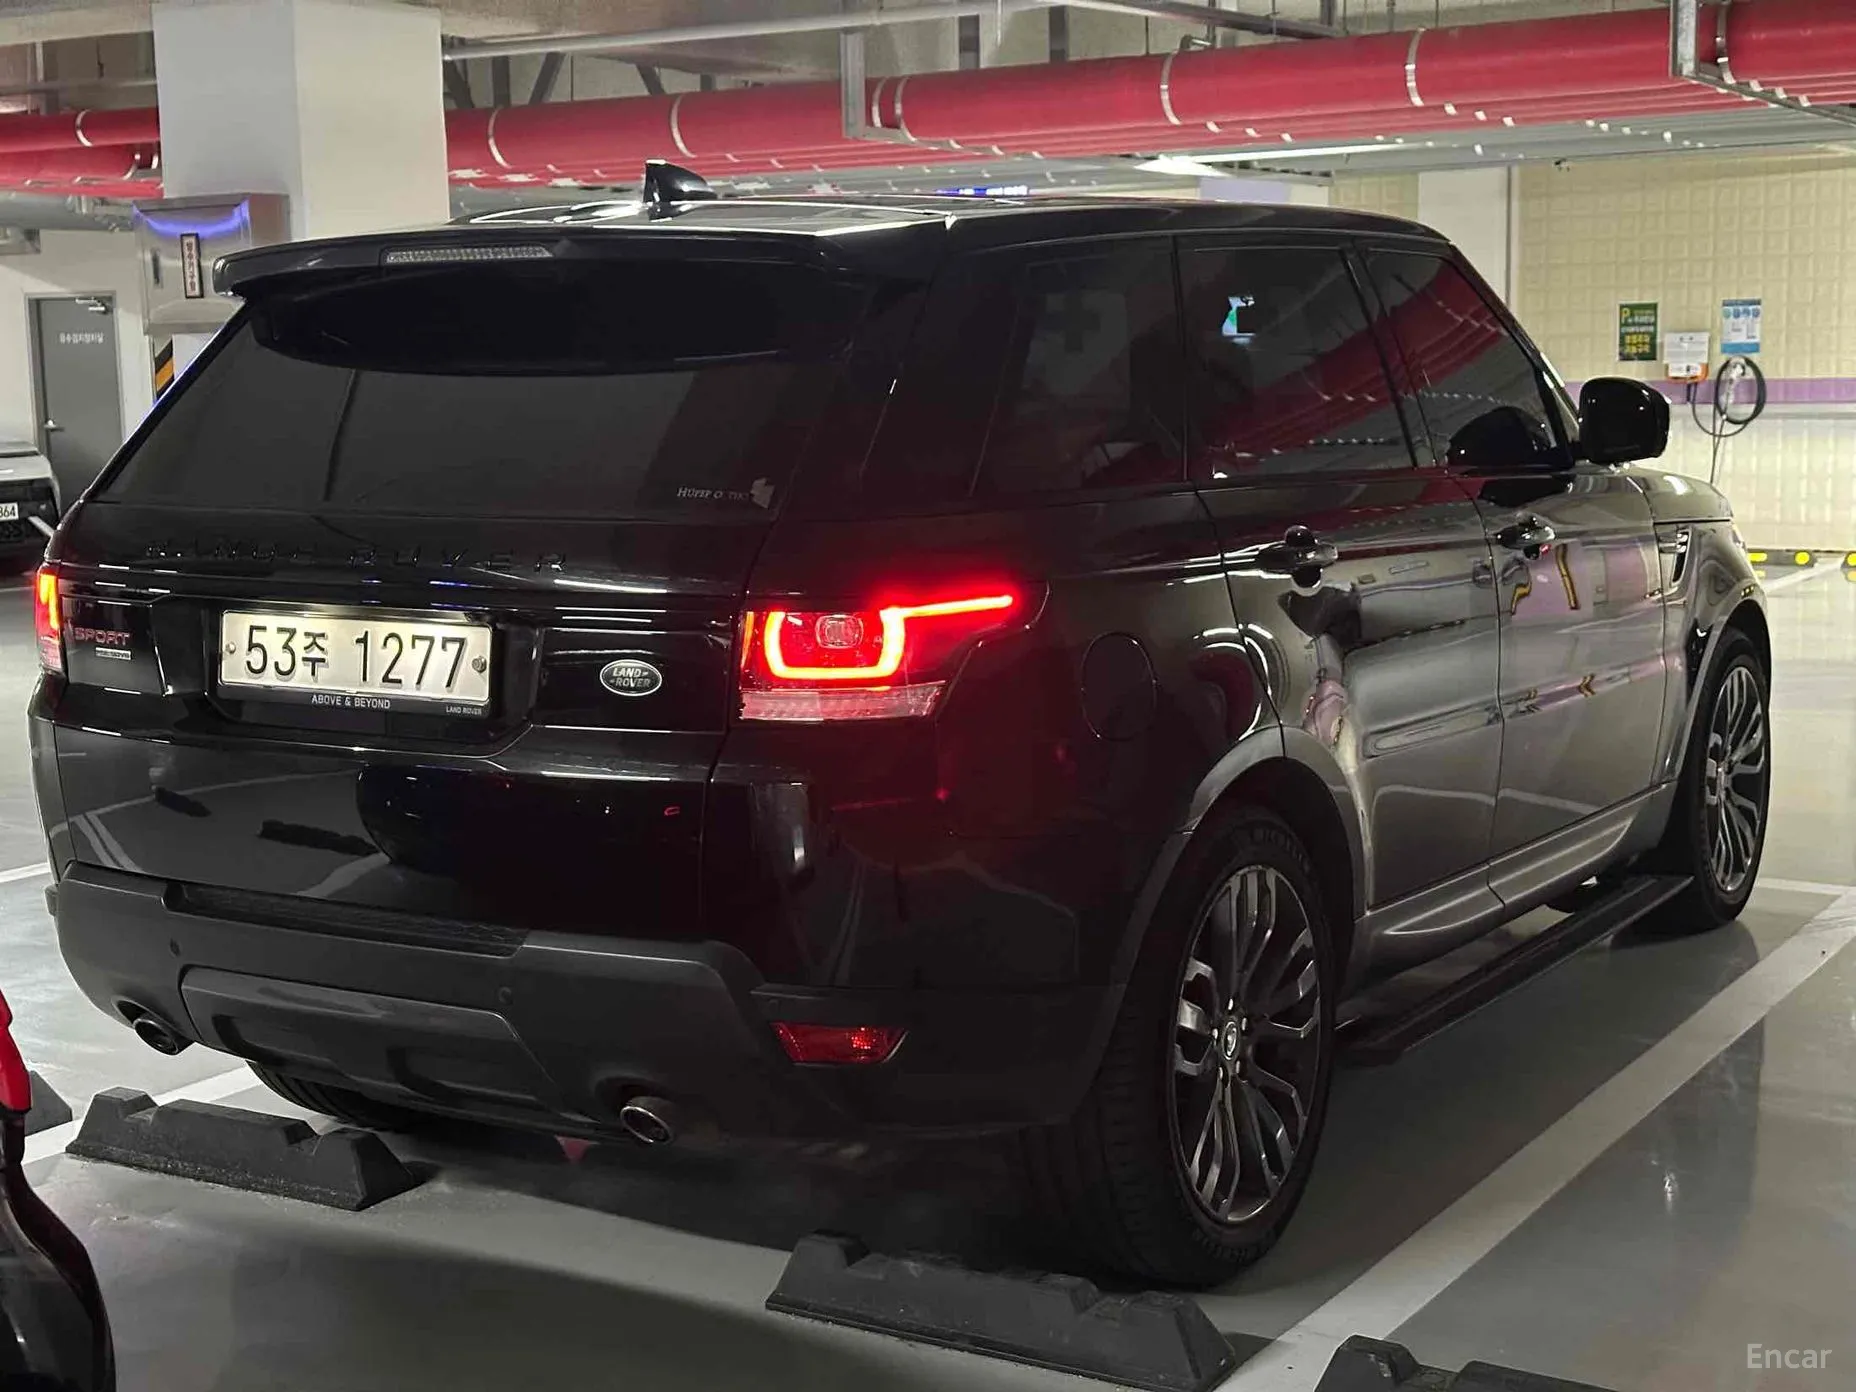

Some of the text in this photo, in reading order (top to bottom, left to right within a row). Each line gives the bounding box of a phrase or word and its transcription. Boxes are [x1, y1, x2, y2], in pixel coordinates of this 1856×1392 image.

[74, 627, 130, 646] SPORT
[245, 625, 467, 689] 53주 1277
[311, 694, 391, 710] ABOVE & BEYOND
[446, 706, 482, 716] LAND ROVER
